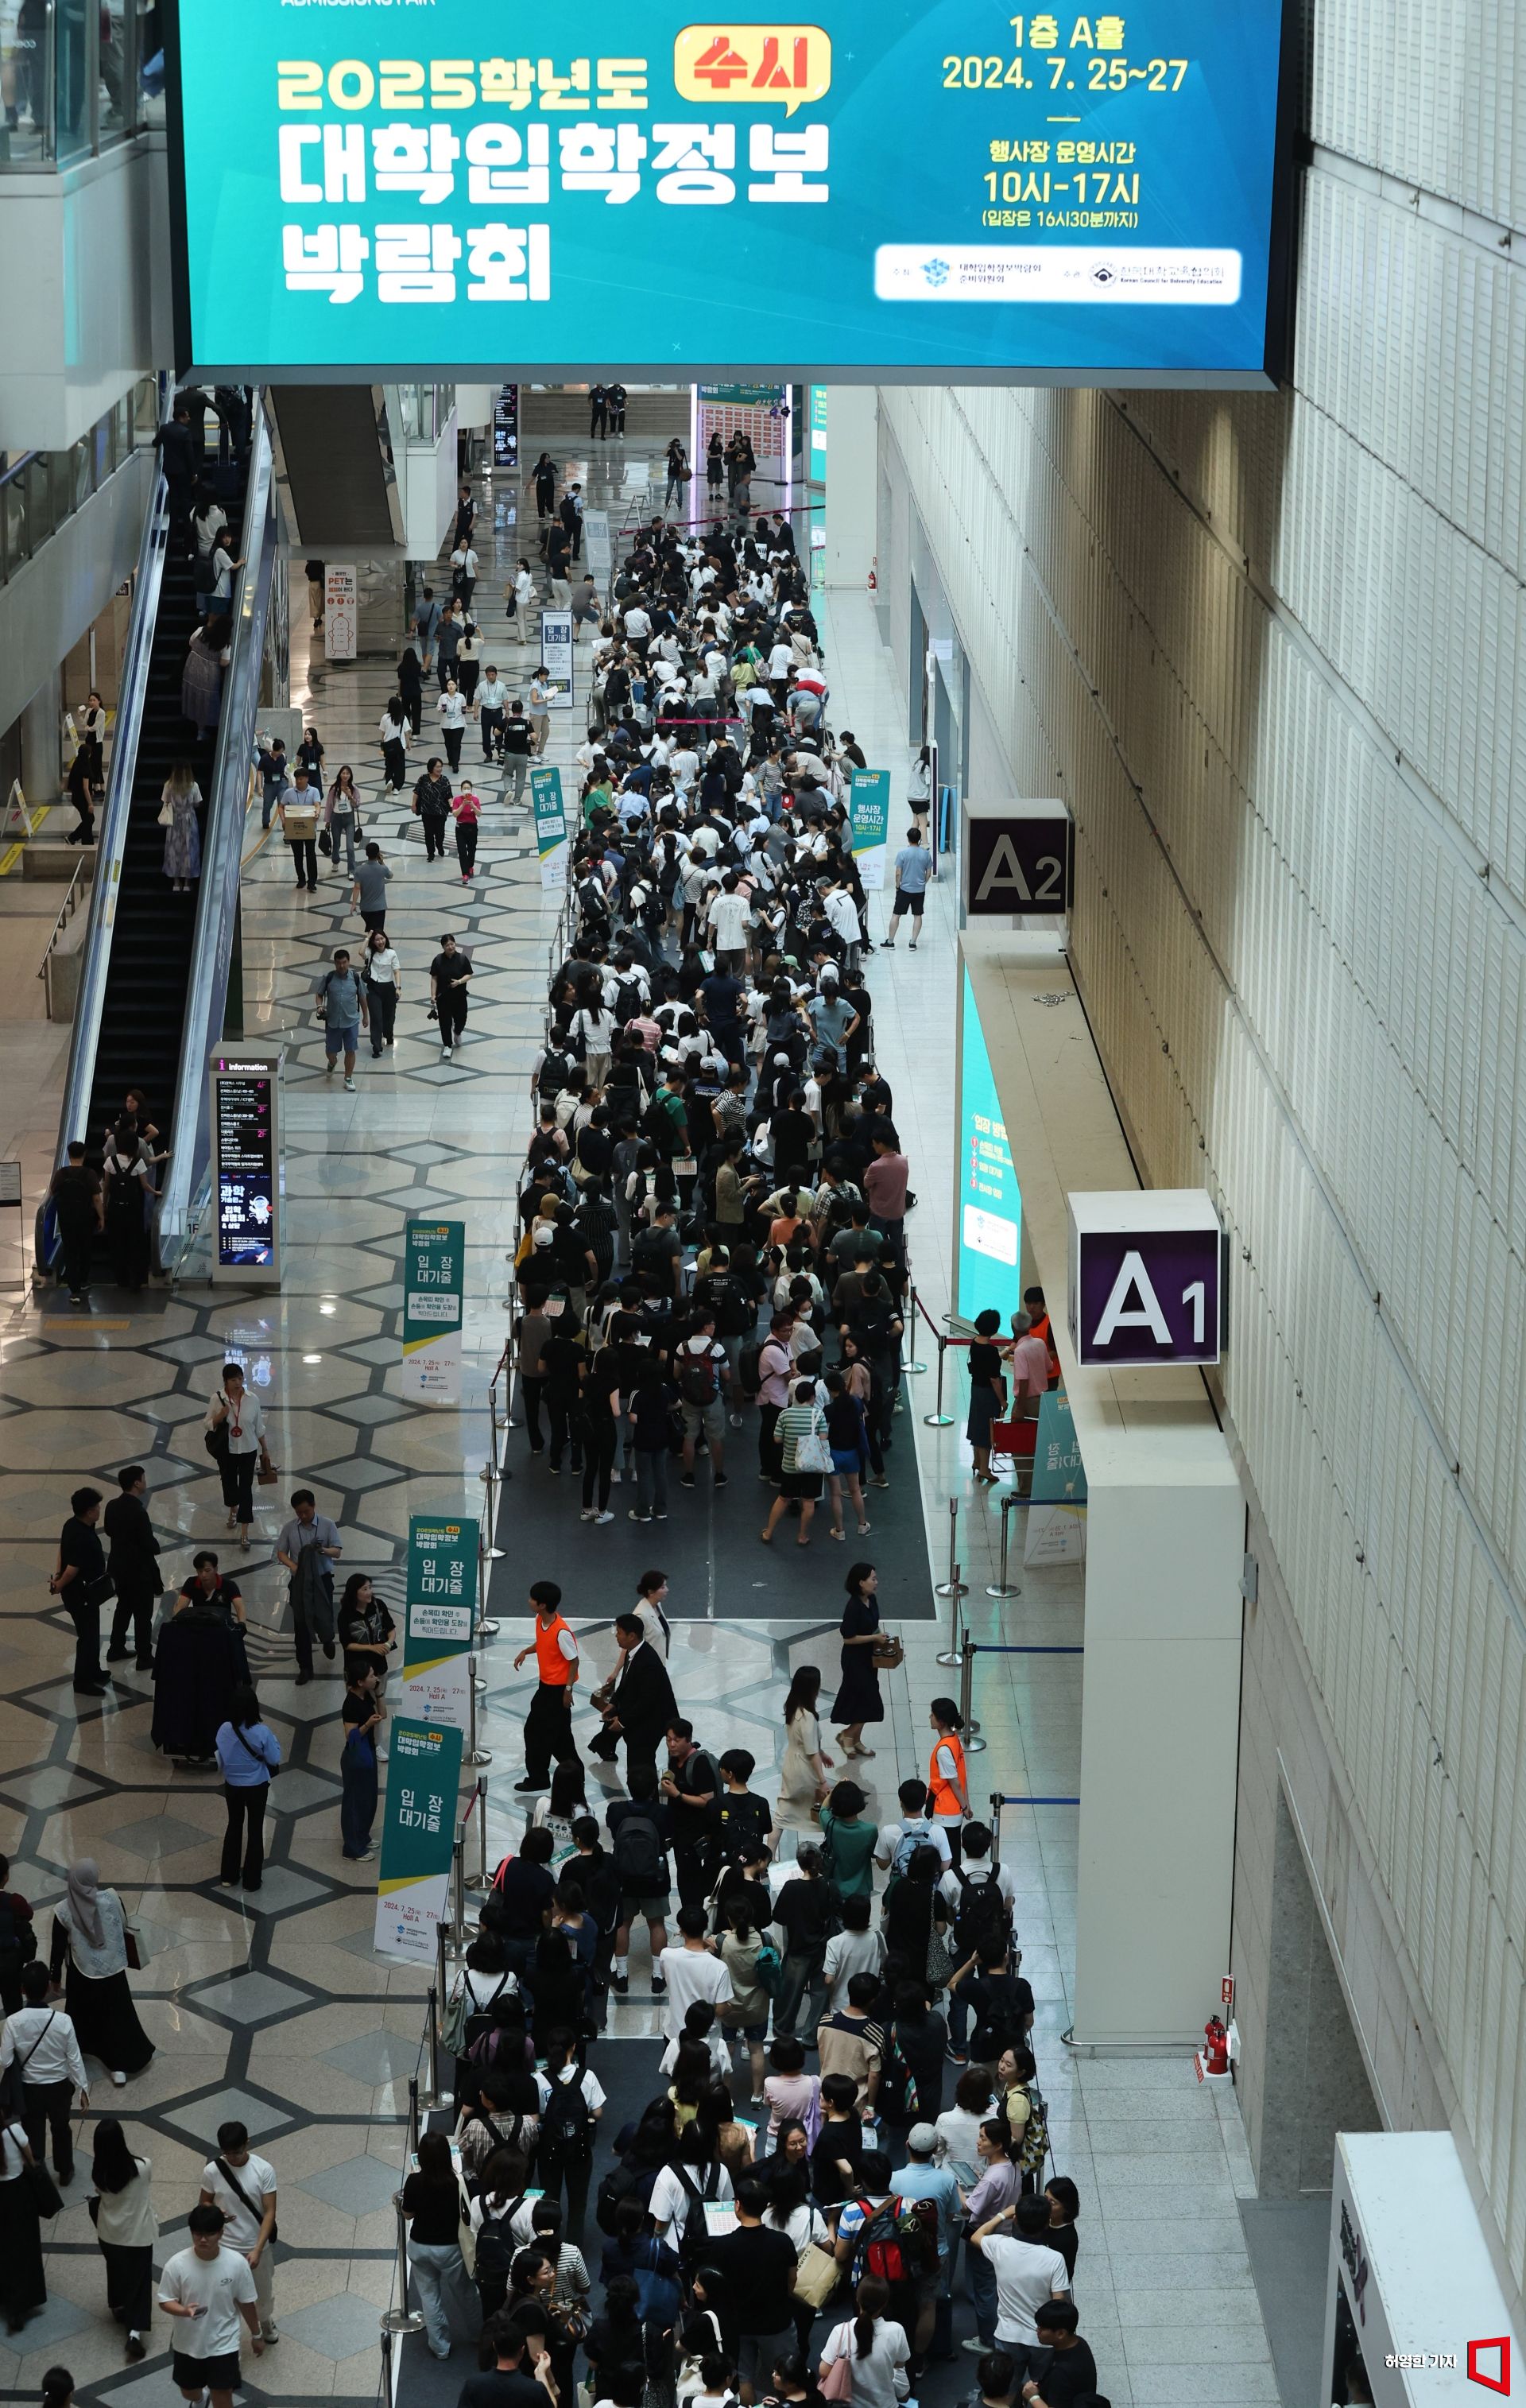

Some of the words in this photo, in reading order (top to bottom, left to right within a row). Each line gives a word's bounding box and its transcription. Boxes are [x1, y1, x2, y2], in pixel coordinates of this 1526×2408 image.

[1009, 16, 1059, 49] 1층
[1070, 16, 1125, 50] A홀
[693, 37, 808, 88] 수시
[943, 56, 1033, 89] 2024.
[1047, 59, 1075, 90] 7.
[1088, 60, 1189, 91] 25~27
[277, 58, 648, 111] 2025학년도
[990, 141, 1051, 164] 행사장
[1056, 141, 1137, 165] 운영시간
[279, 123, 829, 205] 대학입학정보
[984, 172, 1139, 204] 10시-17시
[982, 209, 1032, 228] (입장은
[1036, 211, 1139, 229] 16시30분까지)
[283, 223, 550, 303] 박람회
[853, 813, 884, 824] 운영시간
[858, 804, 881, 815] 행사장
[974, 834, 1063, 902] A2
[220, 1185, 245, 1197] 과학
[417, 1255, 429, 1269] 입
[440, 1256, 453, 1270] 장
[417, 1270, 451, 1284] 대기줄
[1091, 1250, 1206, 1344] A1
[416, 1533, 459, 1542] 대학입학정보
[422, 1559, 436, 1575] 입
[450, 1561, 464, 1576] 장
[421, 1577, 463, 1595] 대기줄
[397, 1736, 441, 1751] 대학입학정보
[397, 1745, 419, 1756] 박람회
[401, 1789, 415, 1807] 입
[428, 1794, 443, 1813] 장
[399, 1808, 440, 1833] 대기줄
[384, 1901, 399, 1911] 2024.
[797, 2250, 811, 2270] BUCKS
